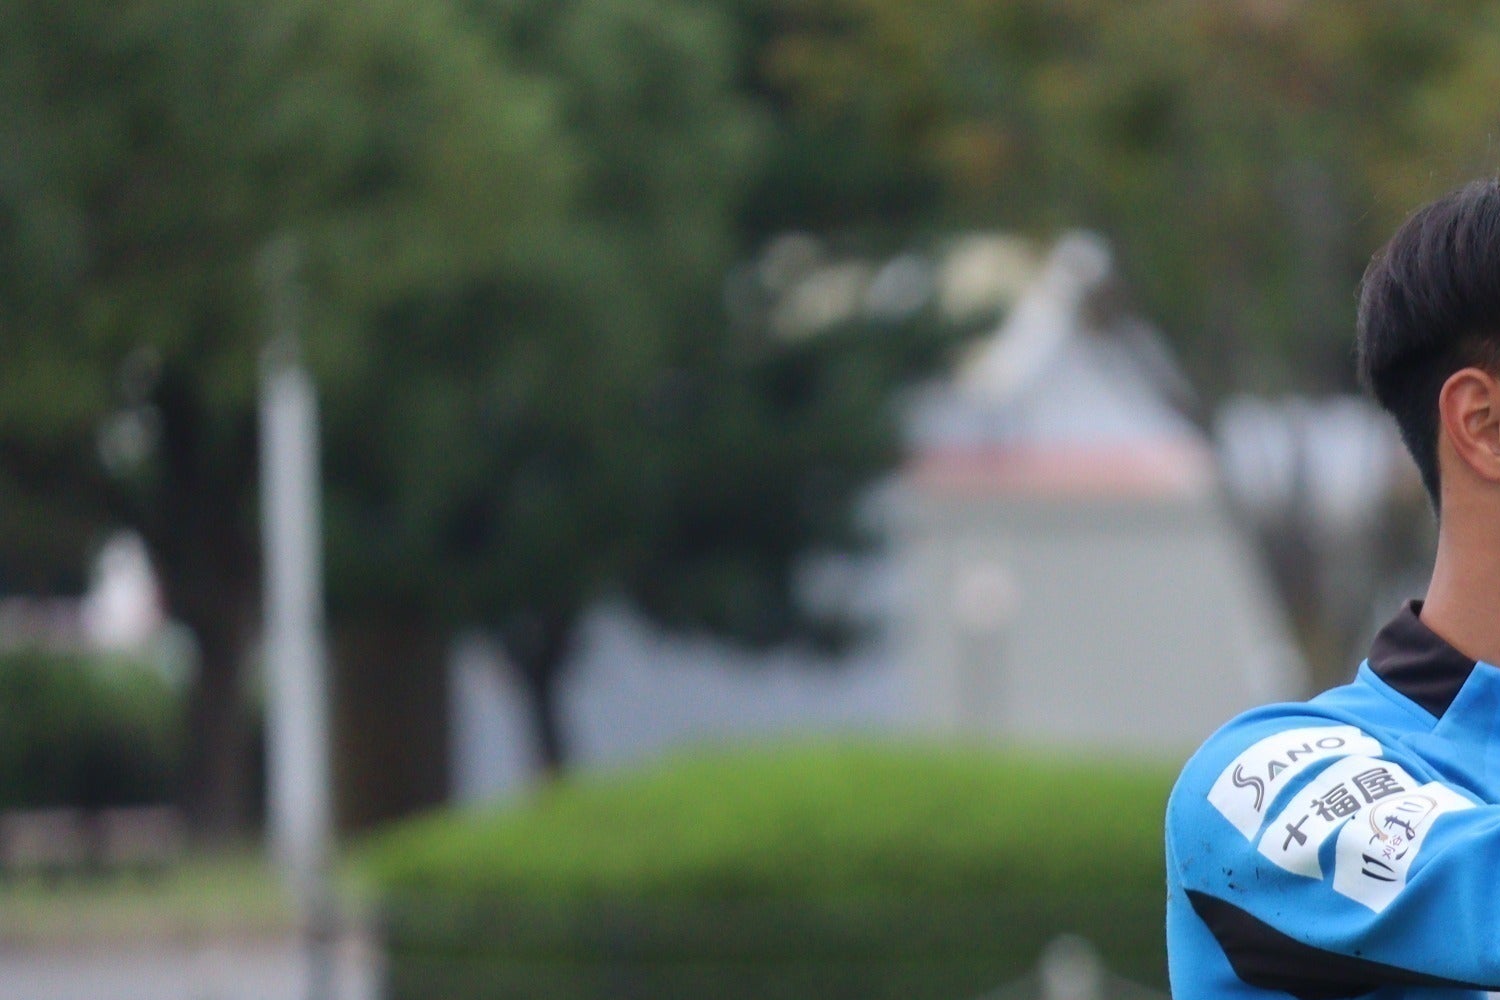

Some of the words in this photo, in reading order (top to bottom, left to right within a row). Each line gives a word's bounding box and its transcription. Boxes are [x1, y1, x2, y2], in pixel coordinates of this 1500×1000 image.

[1232, 737, 1346, 812] SANO
[1283, 767, 1406, 852] 十福屋
